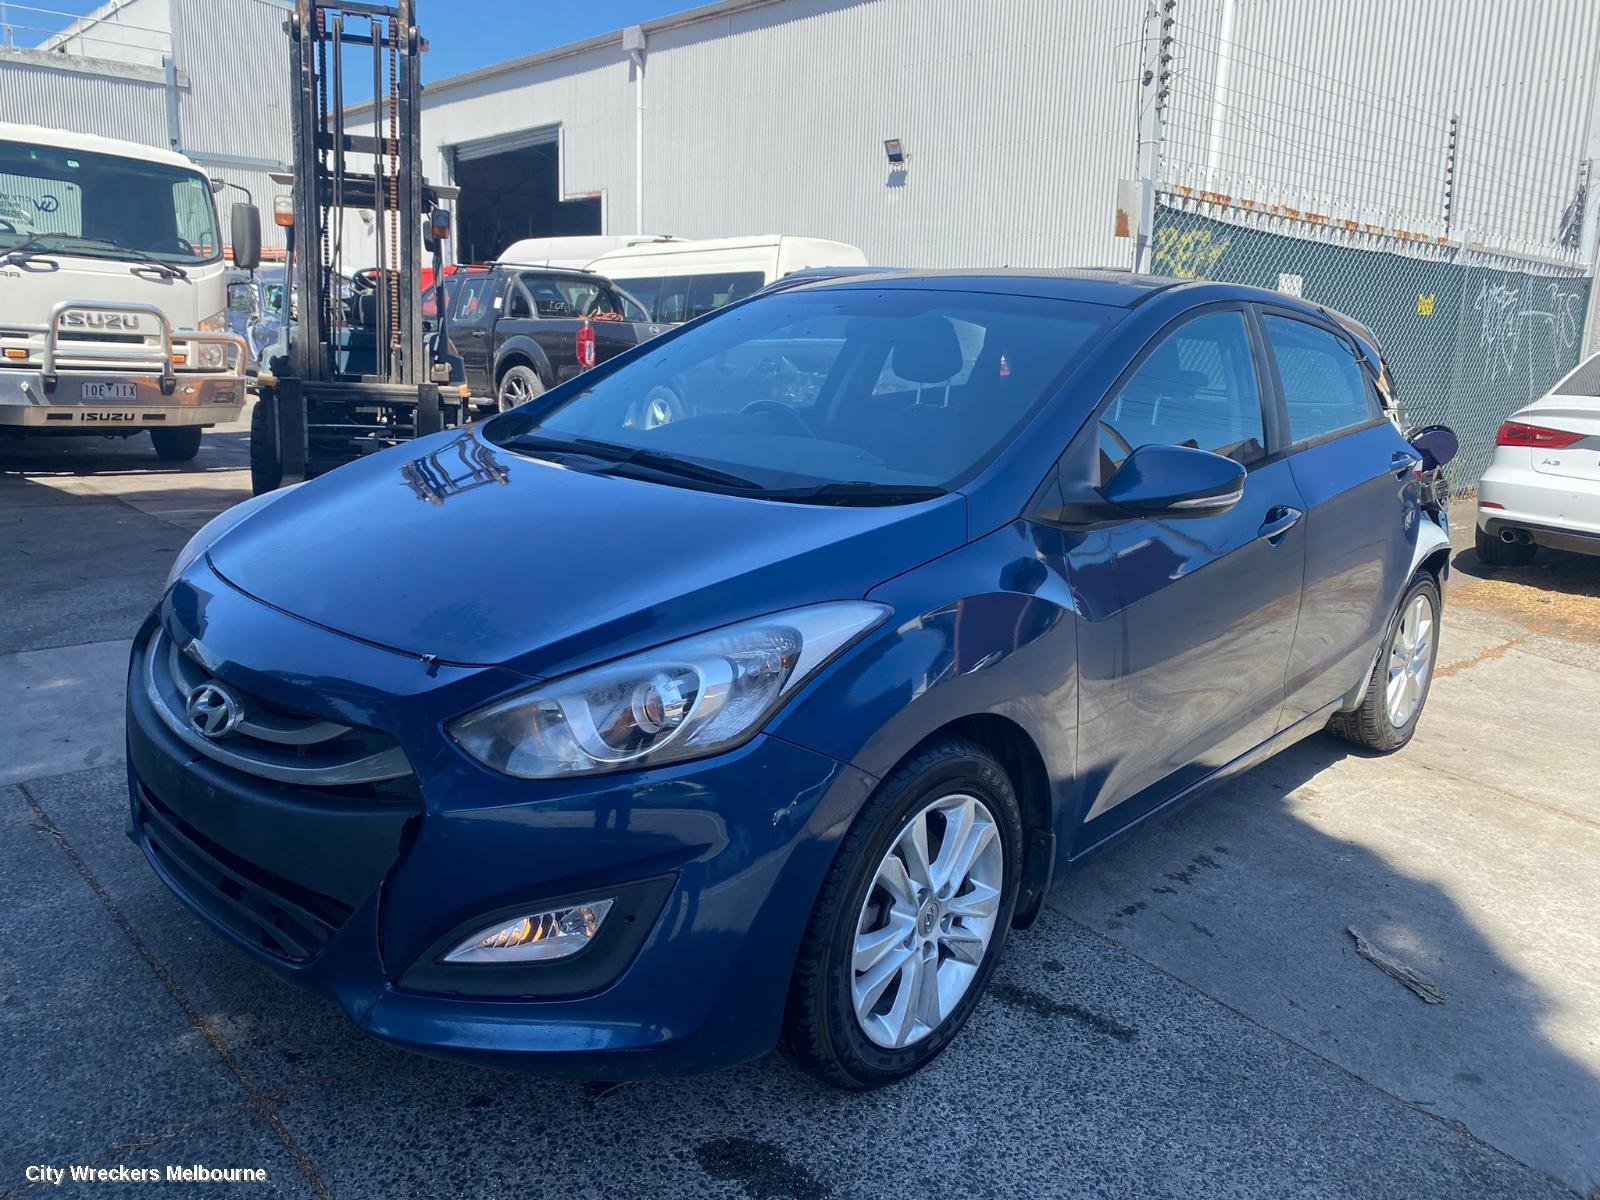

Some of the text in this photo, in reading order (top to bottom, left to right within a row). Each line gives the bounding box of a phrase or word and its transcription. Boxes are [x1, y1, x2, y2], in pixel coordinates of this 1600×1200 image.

[60, 312, 139, 329] ISUZU
[81, 413, 135, 421] ISUZU
[1541, 456, 1560, 466] A3
